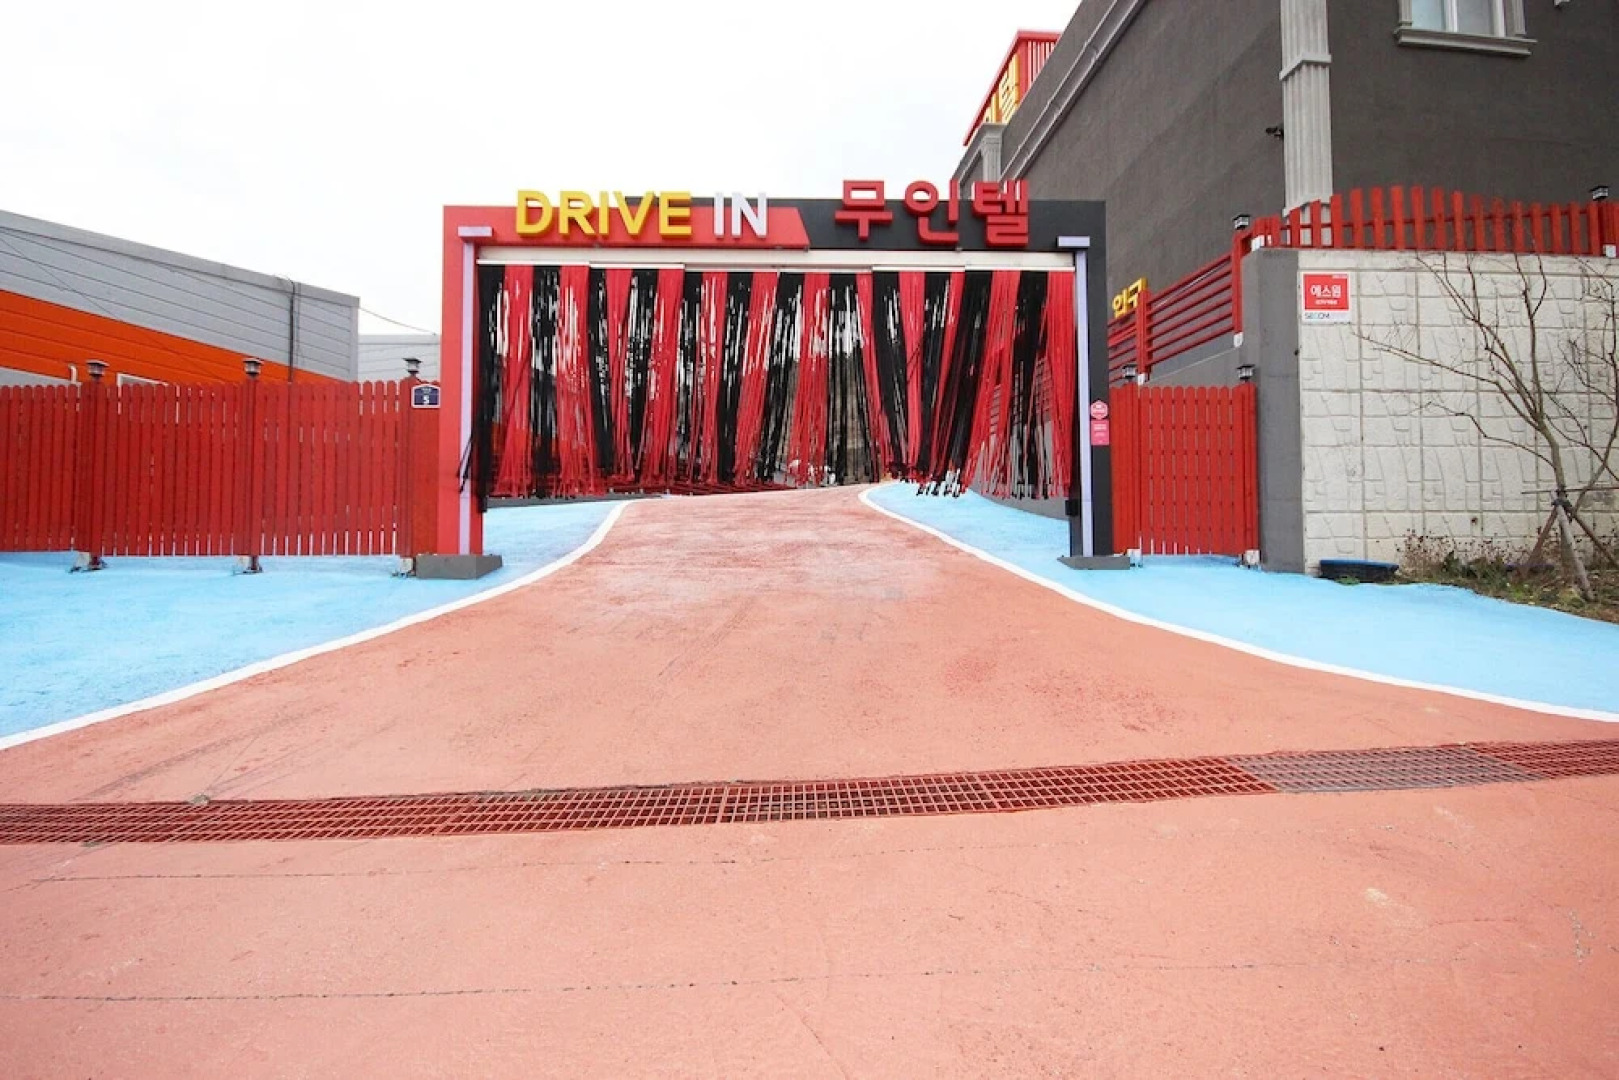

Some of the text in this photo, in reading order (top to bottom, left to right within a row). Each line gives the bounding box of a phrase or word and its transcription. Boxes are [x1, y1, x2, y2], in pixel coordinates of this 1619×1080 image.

[515, 190, 767, 238] DRIVE IN
[835, 179, 1029, 247] 무인텔
